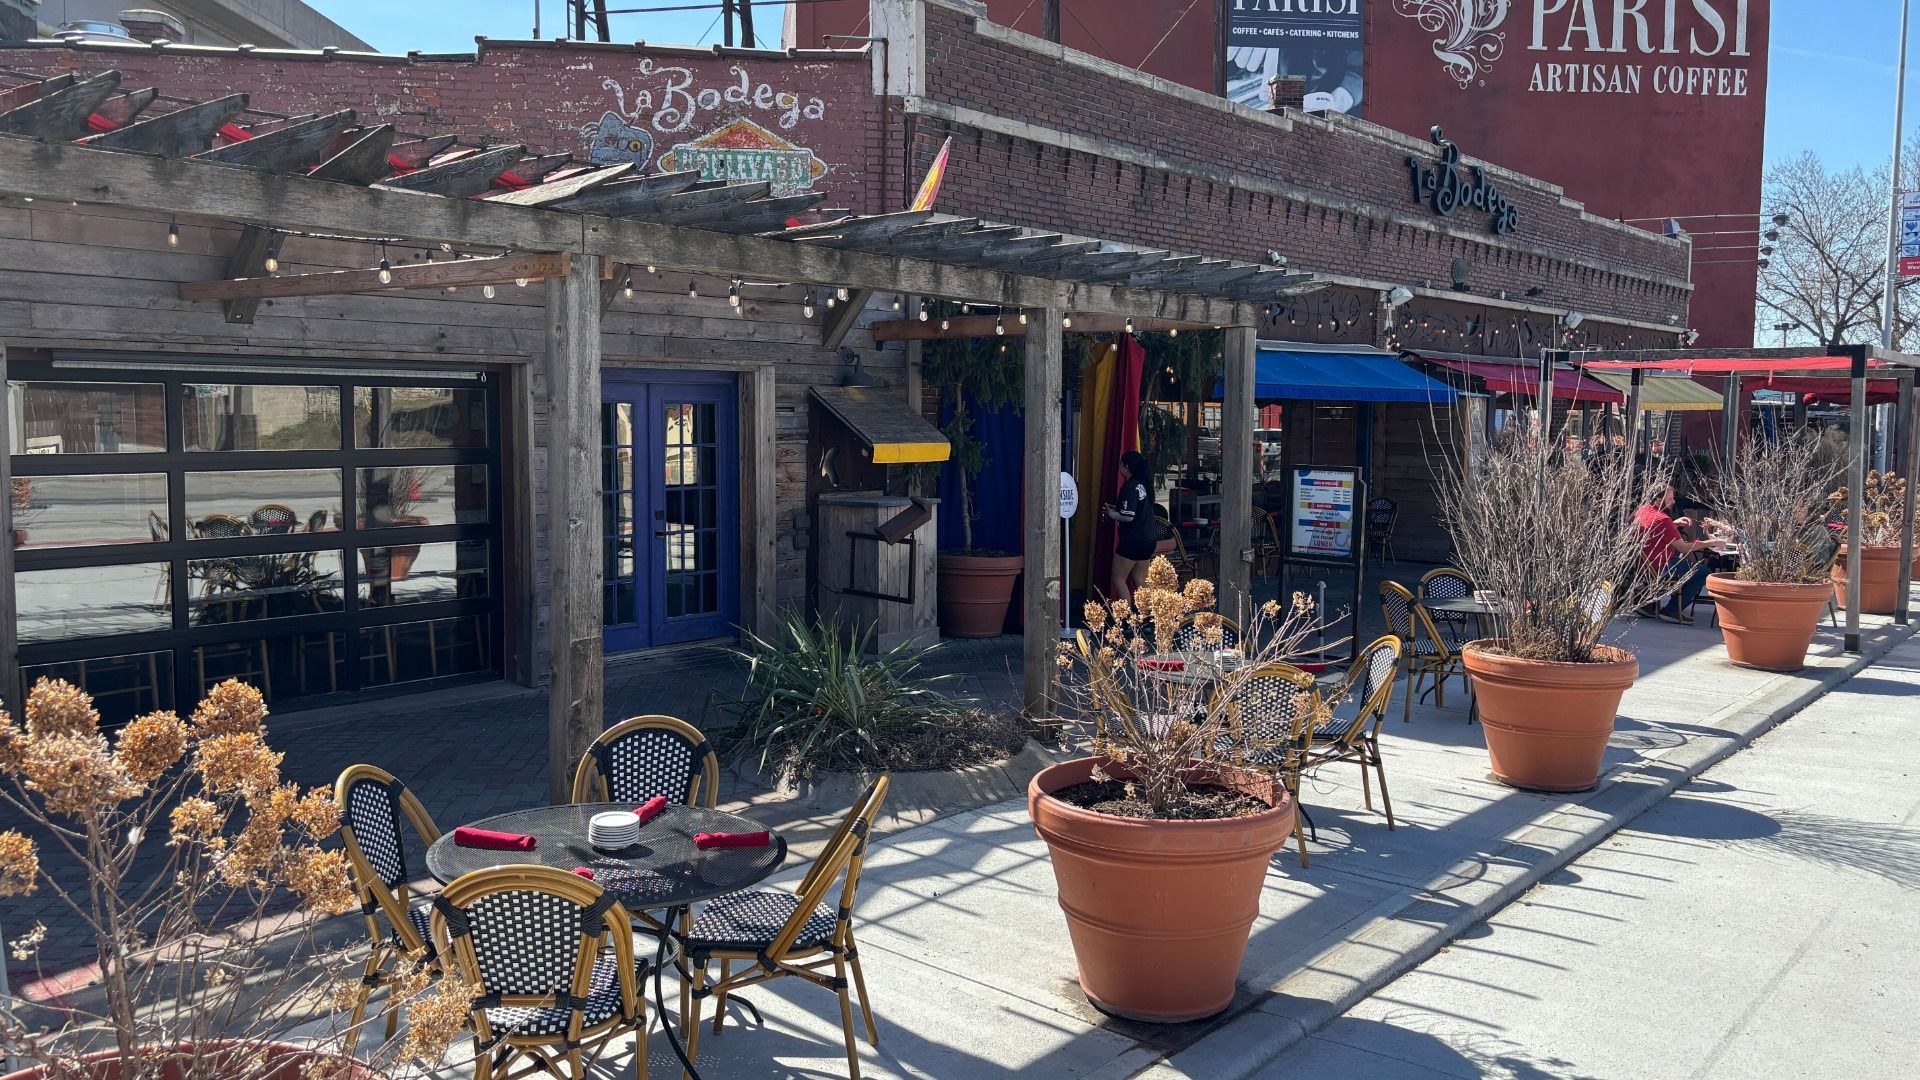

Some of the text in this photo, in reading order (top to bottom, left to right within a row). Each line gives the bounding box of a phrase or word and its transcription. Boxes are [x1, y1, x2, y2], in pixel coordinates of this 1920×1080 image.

[1232, 26, 1359, 39] COFFEE CAFÉS CATERING KITCHENS
[1527, 0, 1751, 56] PARISI
[602, 58, 825, 133] La Bodega
[1527, 62, 1749, 96] ARTISAN COFFEE
[1407, 125, 1520, 235] La Bodega
